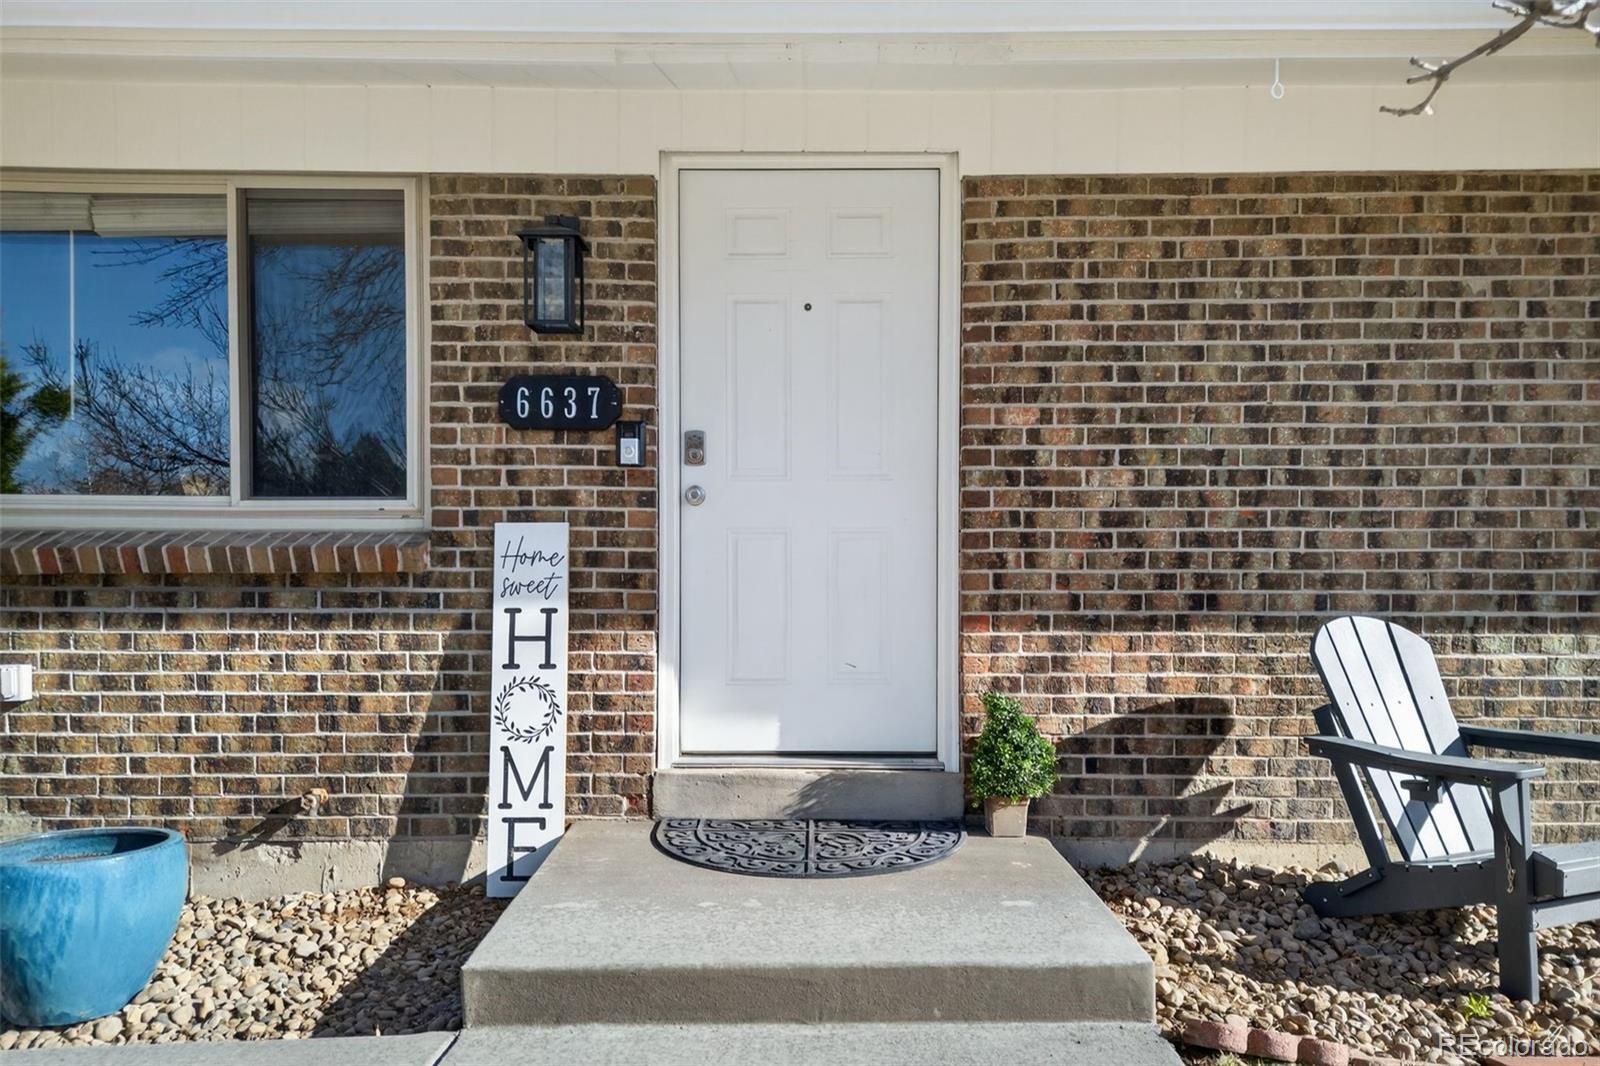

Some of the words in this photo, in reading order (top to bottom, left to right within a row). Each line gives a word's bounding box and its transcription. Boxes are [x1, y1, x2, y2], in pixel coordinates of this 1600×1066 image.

[516, 386, 601, 419] 6637
[500, 535, 566, 573] Home
[500, 571, 564, 601] sweet
